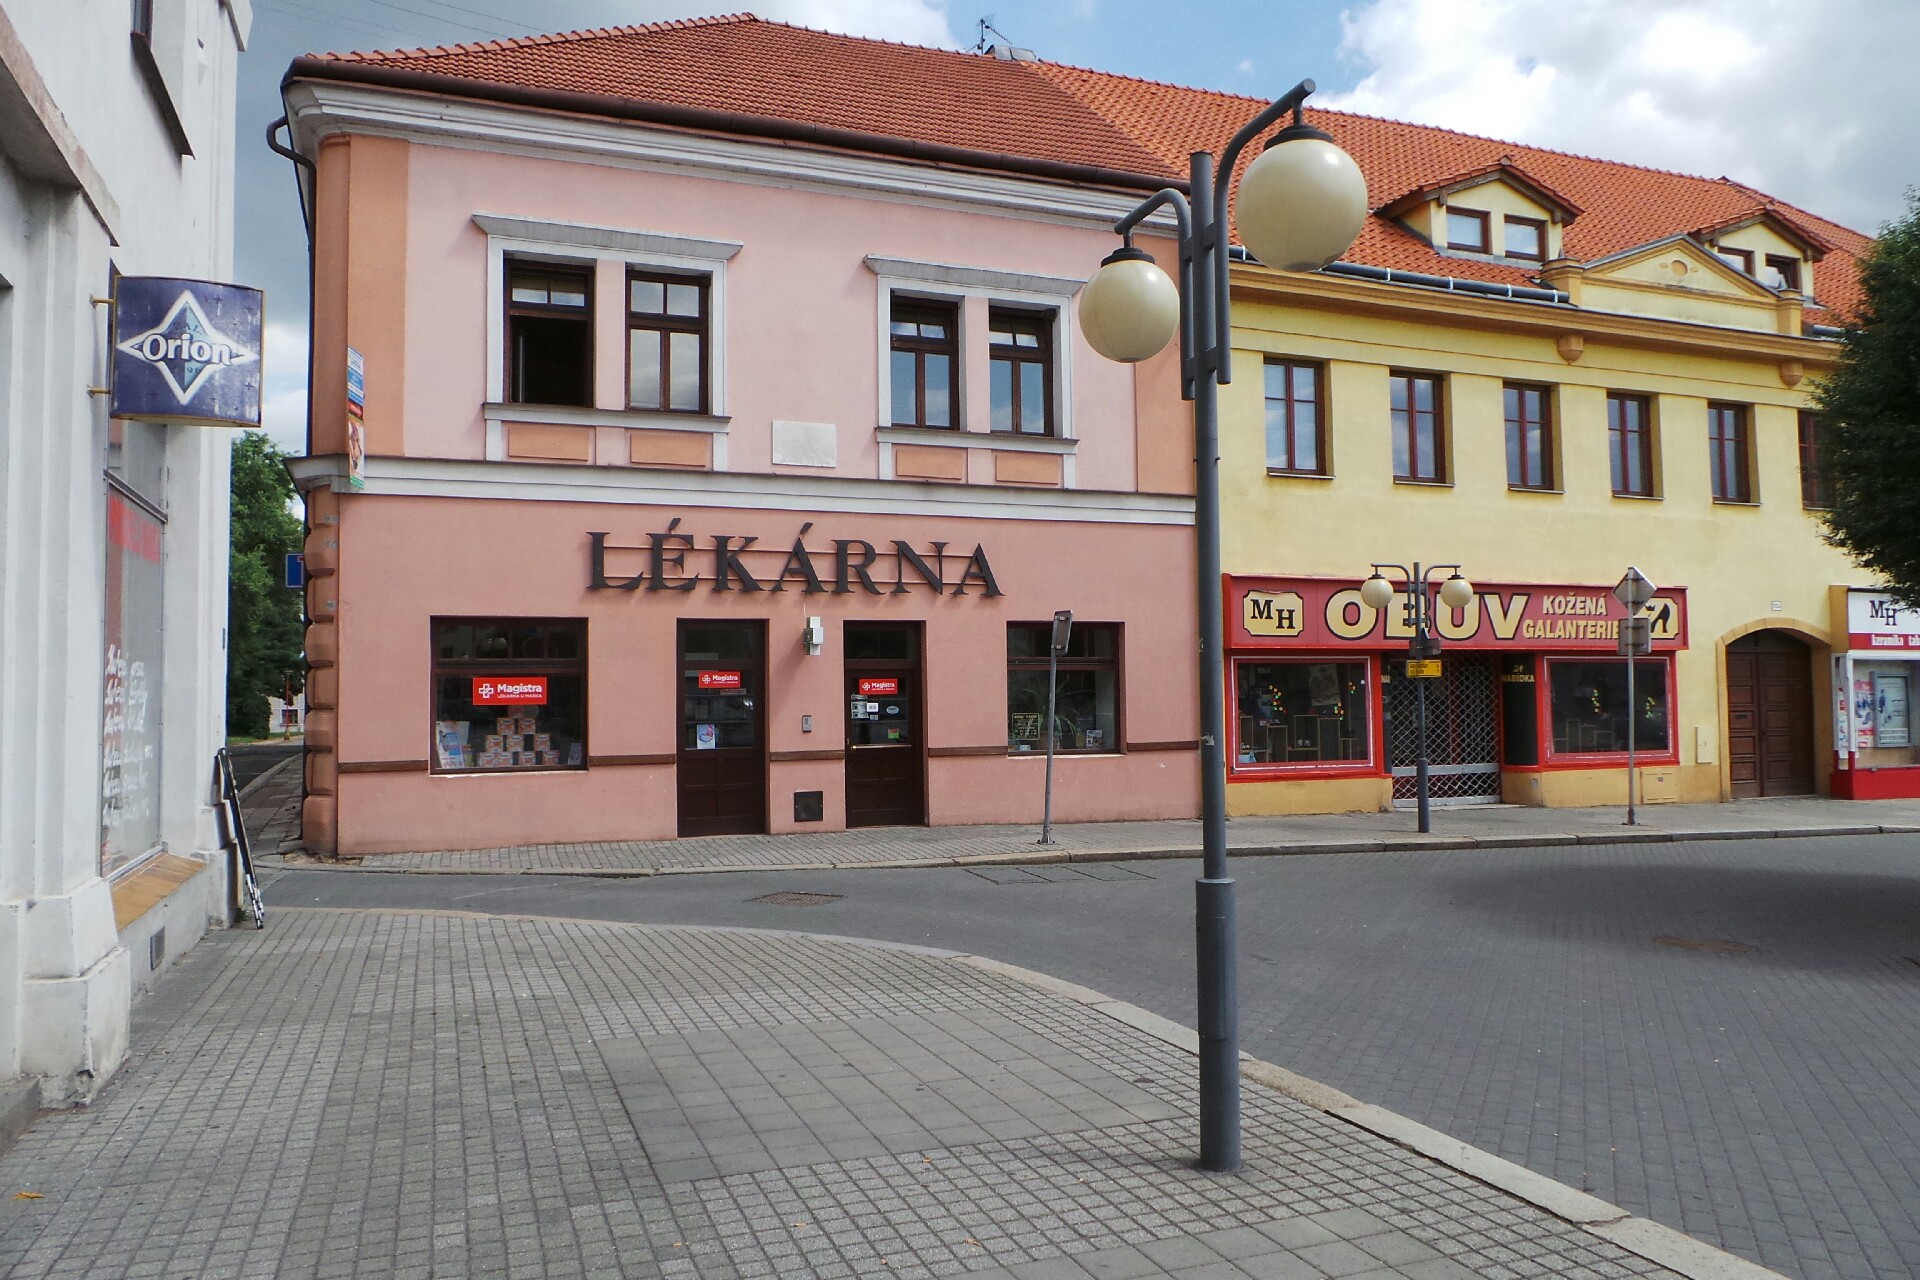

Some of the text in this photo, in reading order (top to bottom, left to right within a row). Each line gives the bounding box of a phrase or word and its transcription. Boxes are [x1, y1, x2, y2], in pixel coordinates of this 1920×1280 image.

[142, 333, 231, 366] Orion
[586, 518, 1006, 597] LÉKÁRNA
[1250, 599, 1296, 630] MH
[1324, 587, 1531, 641] OBUV
[1542, 592, 1608, 616] KOŽENÁ
[1869, 600, 1898, 626] MH
[1522, 619, 1619, 640] GALANTERIE
[497, 683, 543, 694] Magistra
[712, 674, 738, 682] Magistra
